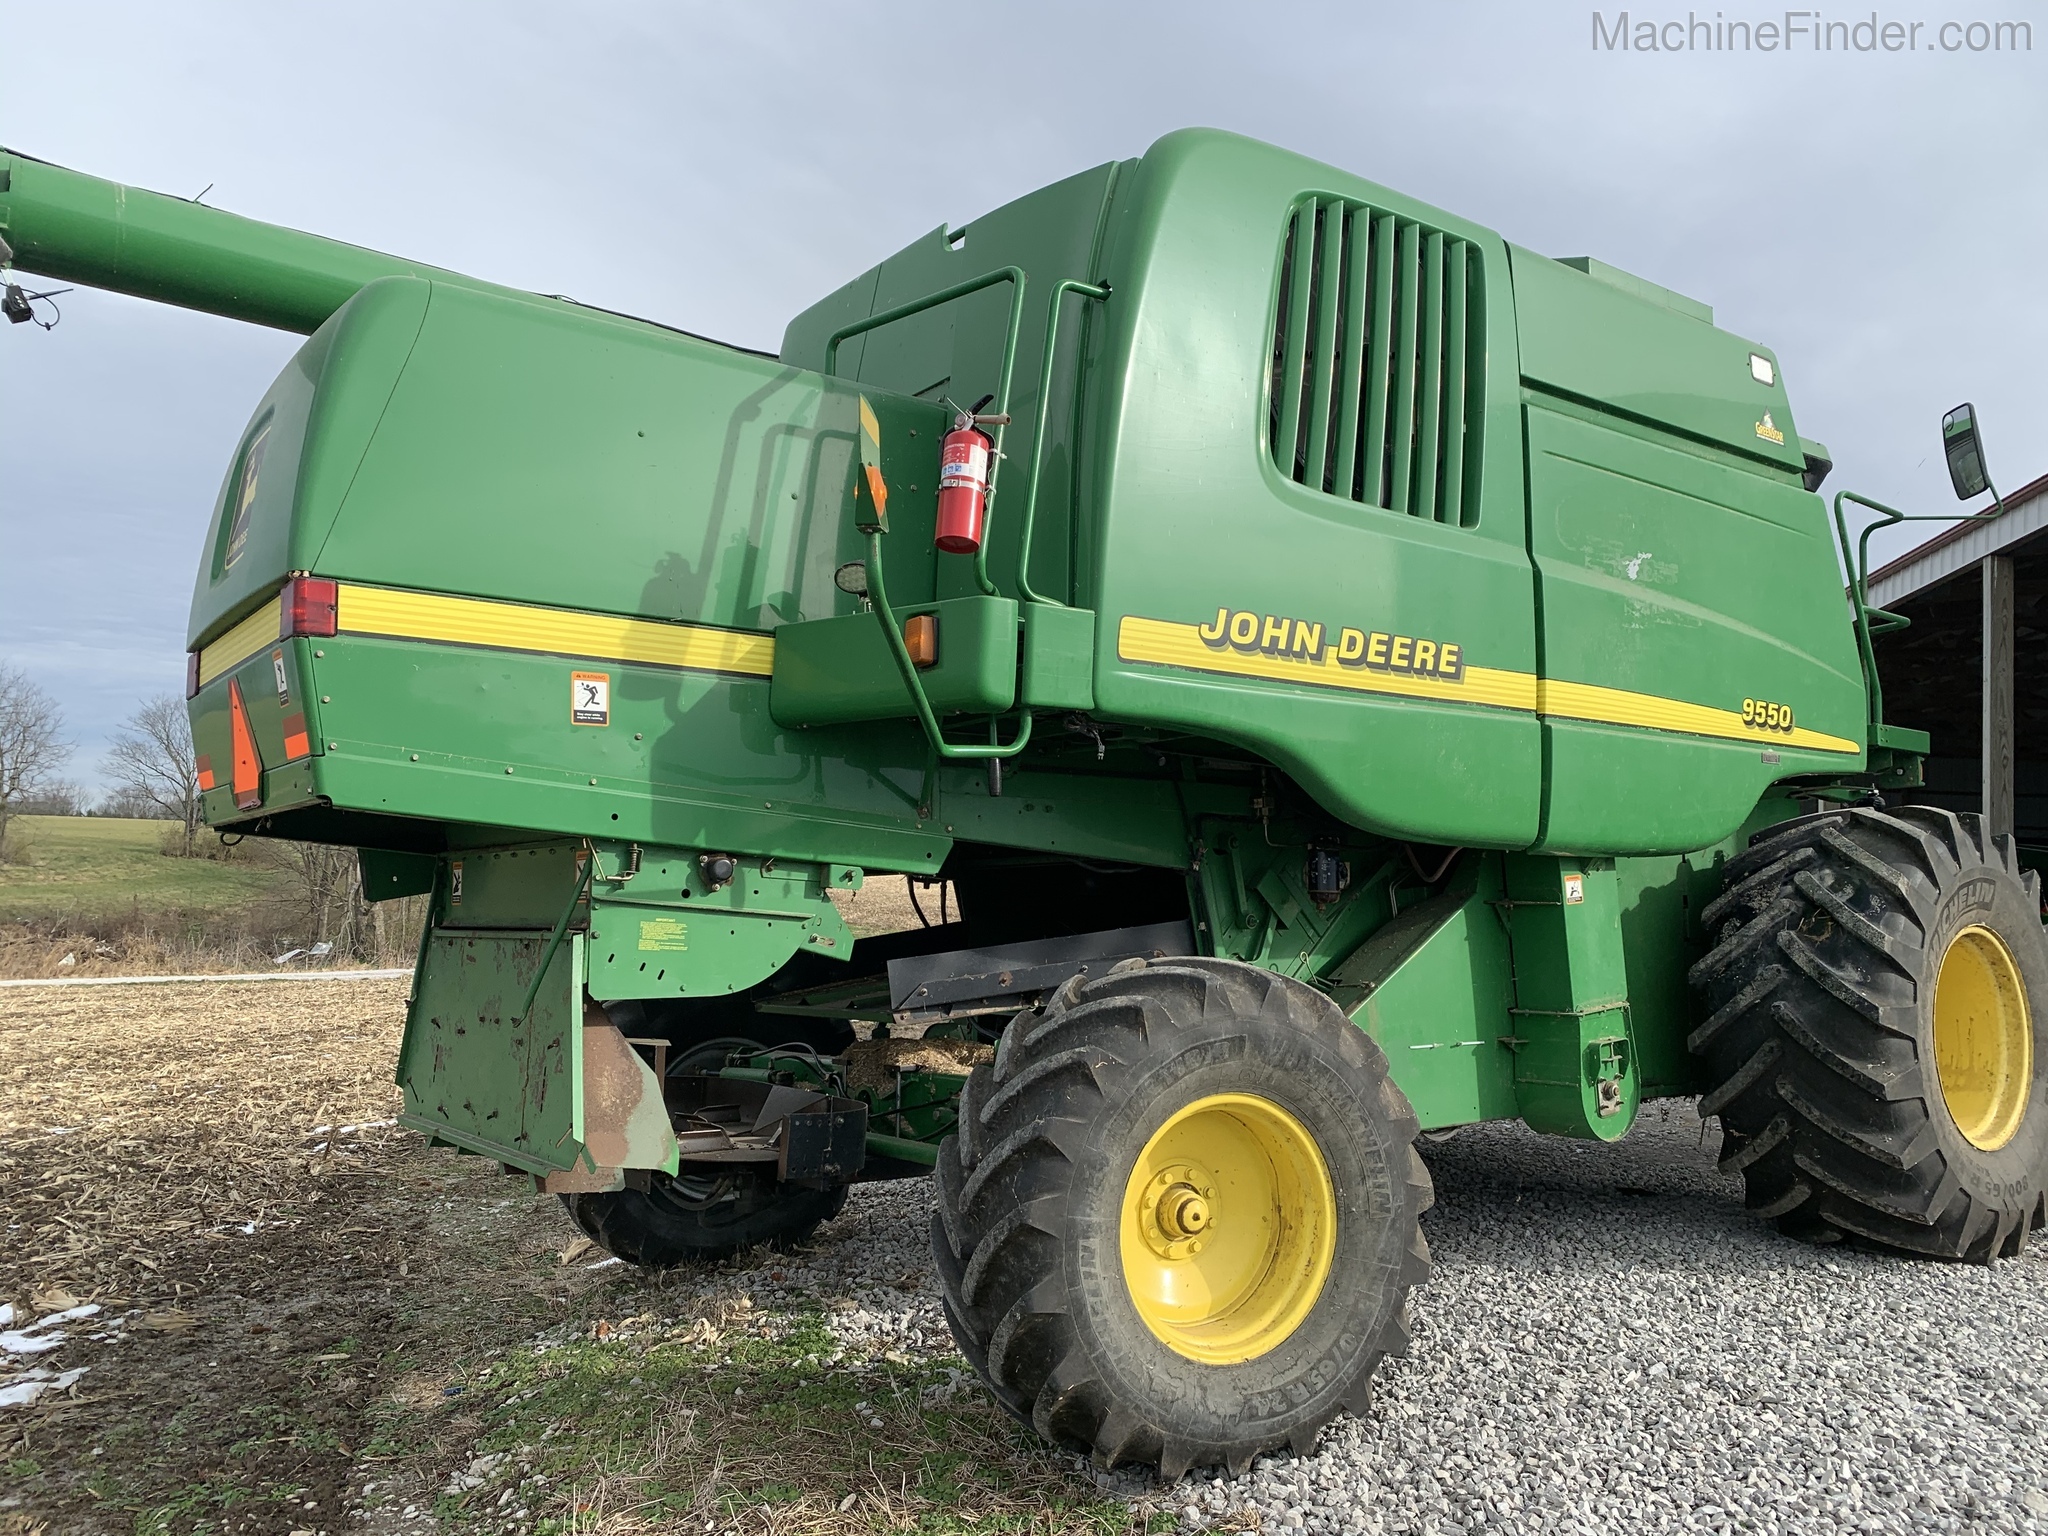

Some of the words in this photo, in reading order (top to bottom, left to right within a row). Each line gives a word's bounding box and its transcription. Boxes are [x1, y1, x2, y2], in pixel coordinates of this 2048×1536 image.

[1199, 607, 1325, 661] JOHN
[1337, 627, 1463, 680] DEERE
[1742, 697, 1793, 732] 9550
